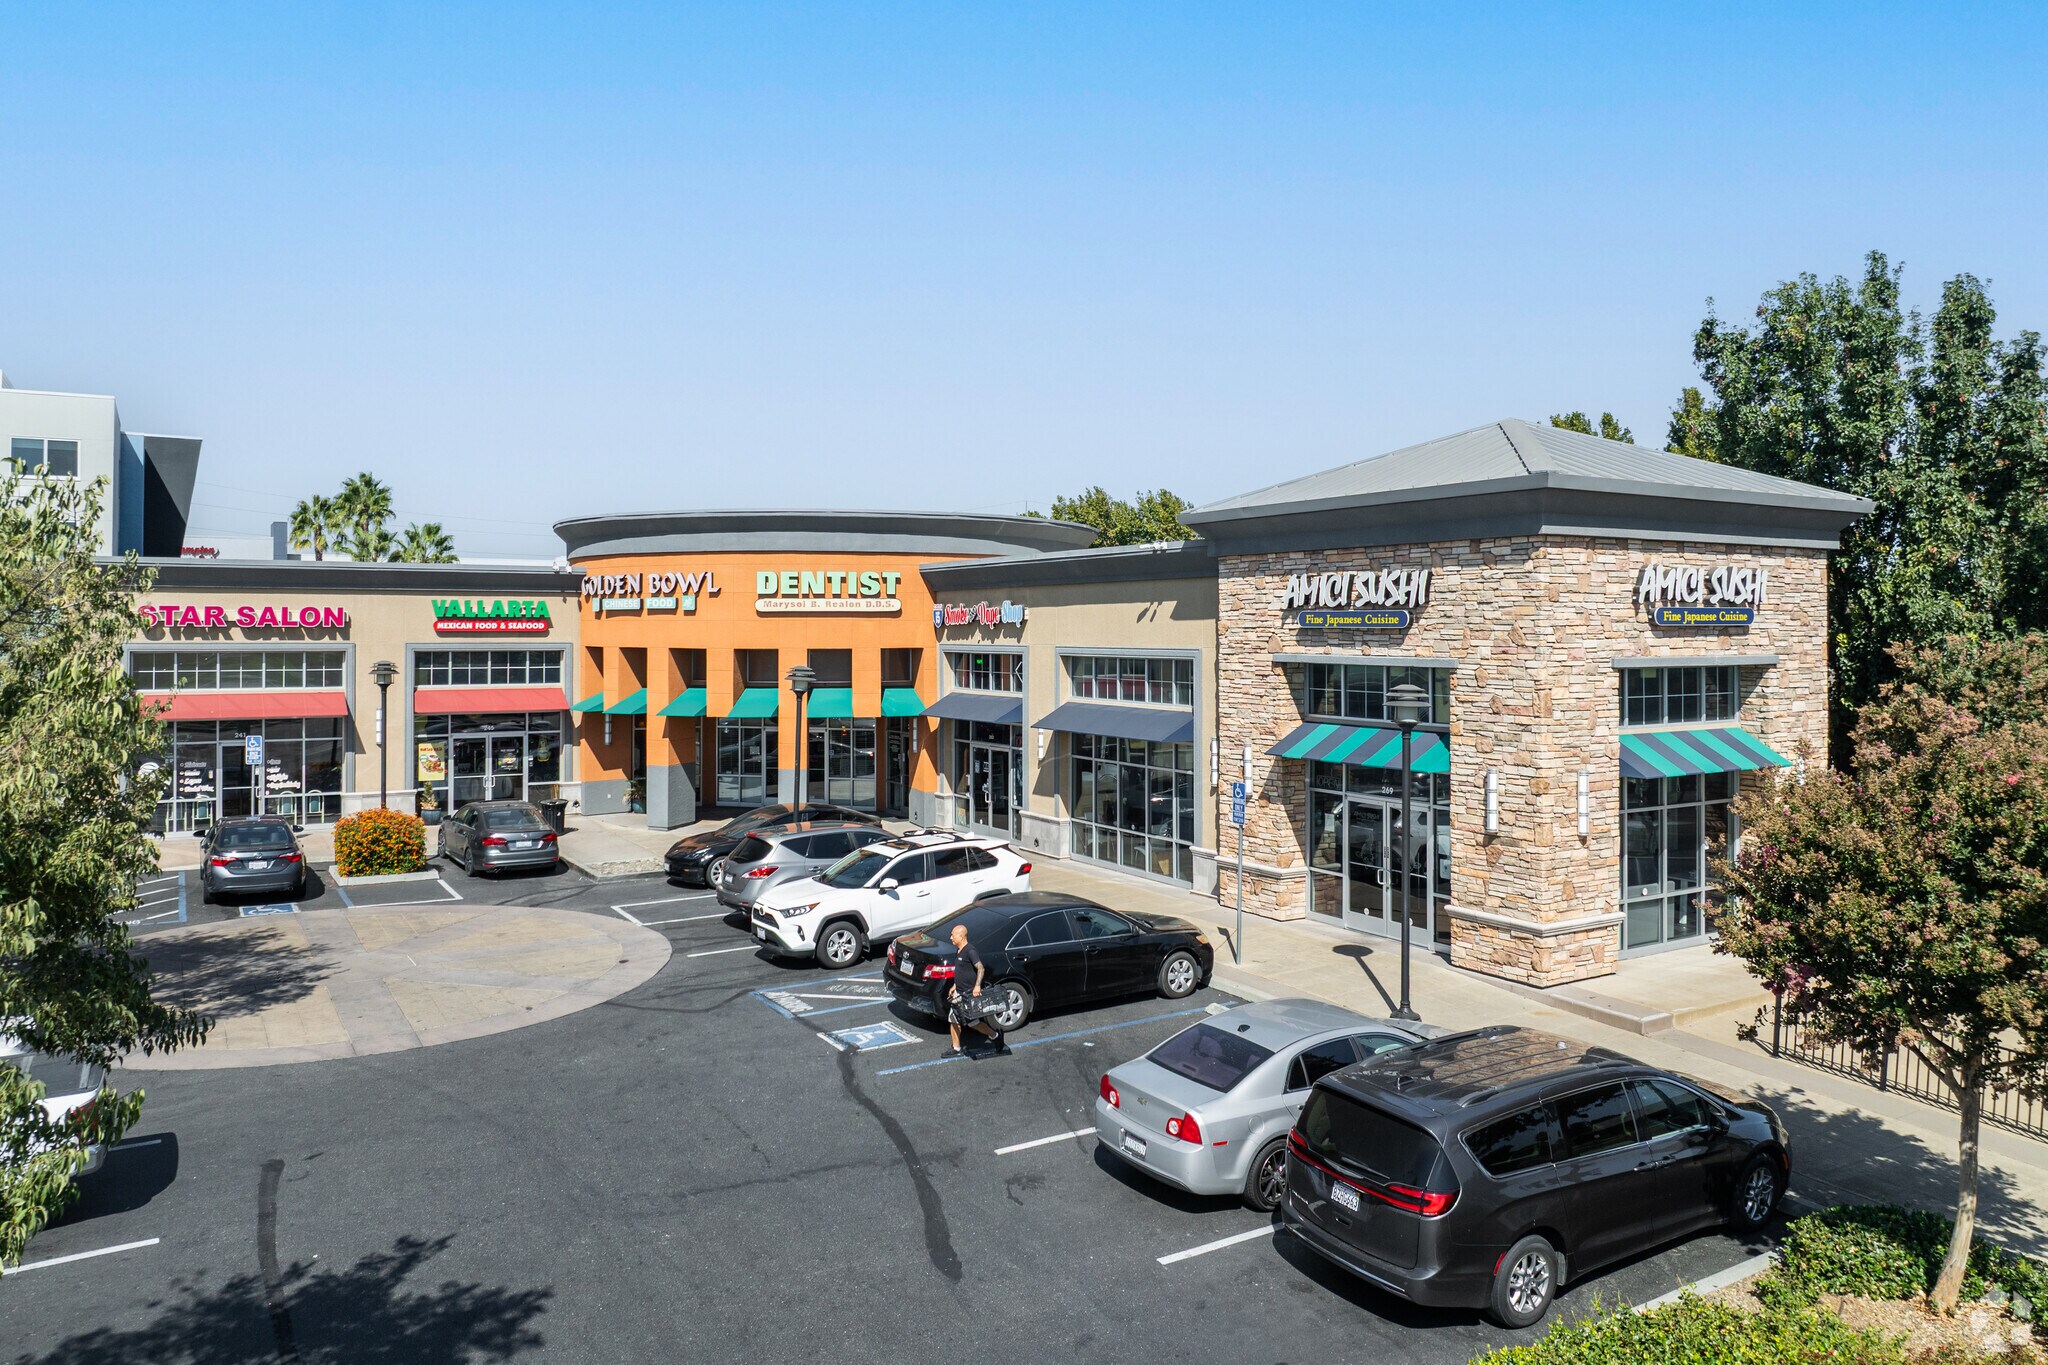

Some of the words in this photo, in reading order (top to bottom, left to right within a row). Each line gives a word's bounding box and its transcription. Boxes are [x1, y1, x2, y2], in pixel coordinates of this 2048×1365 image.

[582, 573, 640, 596] GOLDEN
[647, 571, 720, 593] BOWL
[756, 571, 901, 595] DENTIST
[1283, 572, 1351, 609] AMICI
[1355, 569, 1428, 608] SUSHI
[1638, 564, 1704, 604] AMICI
[1709, 566, 1768, 605] SUSHI
[431, 599, 551, 618] VALLARTA
[604, 599, 639, 608] CHINESE
[646, 599, 673, 607] FOOD
[763, 600, 806, 609] Marysol
[138, 605, 227, 627] STAR
[234, 605, 345, 628] SALON
[944, 604, 969, 626] Smoke
[977, 601, 1000, 629] Vape
[1001, 600, 1023, 628] Shop
[1305, 614, 1323, 624] Fine
[1325, 614, 1362, 627] Japanese
[1364, 614, 1399, 624] Cuisine
[1663, 611, 1681, 621] Fine
[1683, 611, 1717, 625] Japanese
[1719, 611, 1748, 622] Cuisine
[1381, 786, 1394, 795] 269
